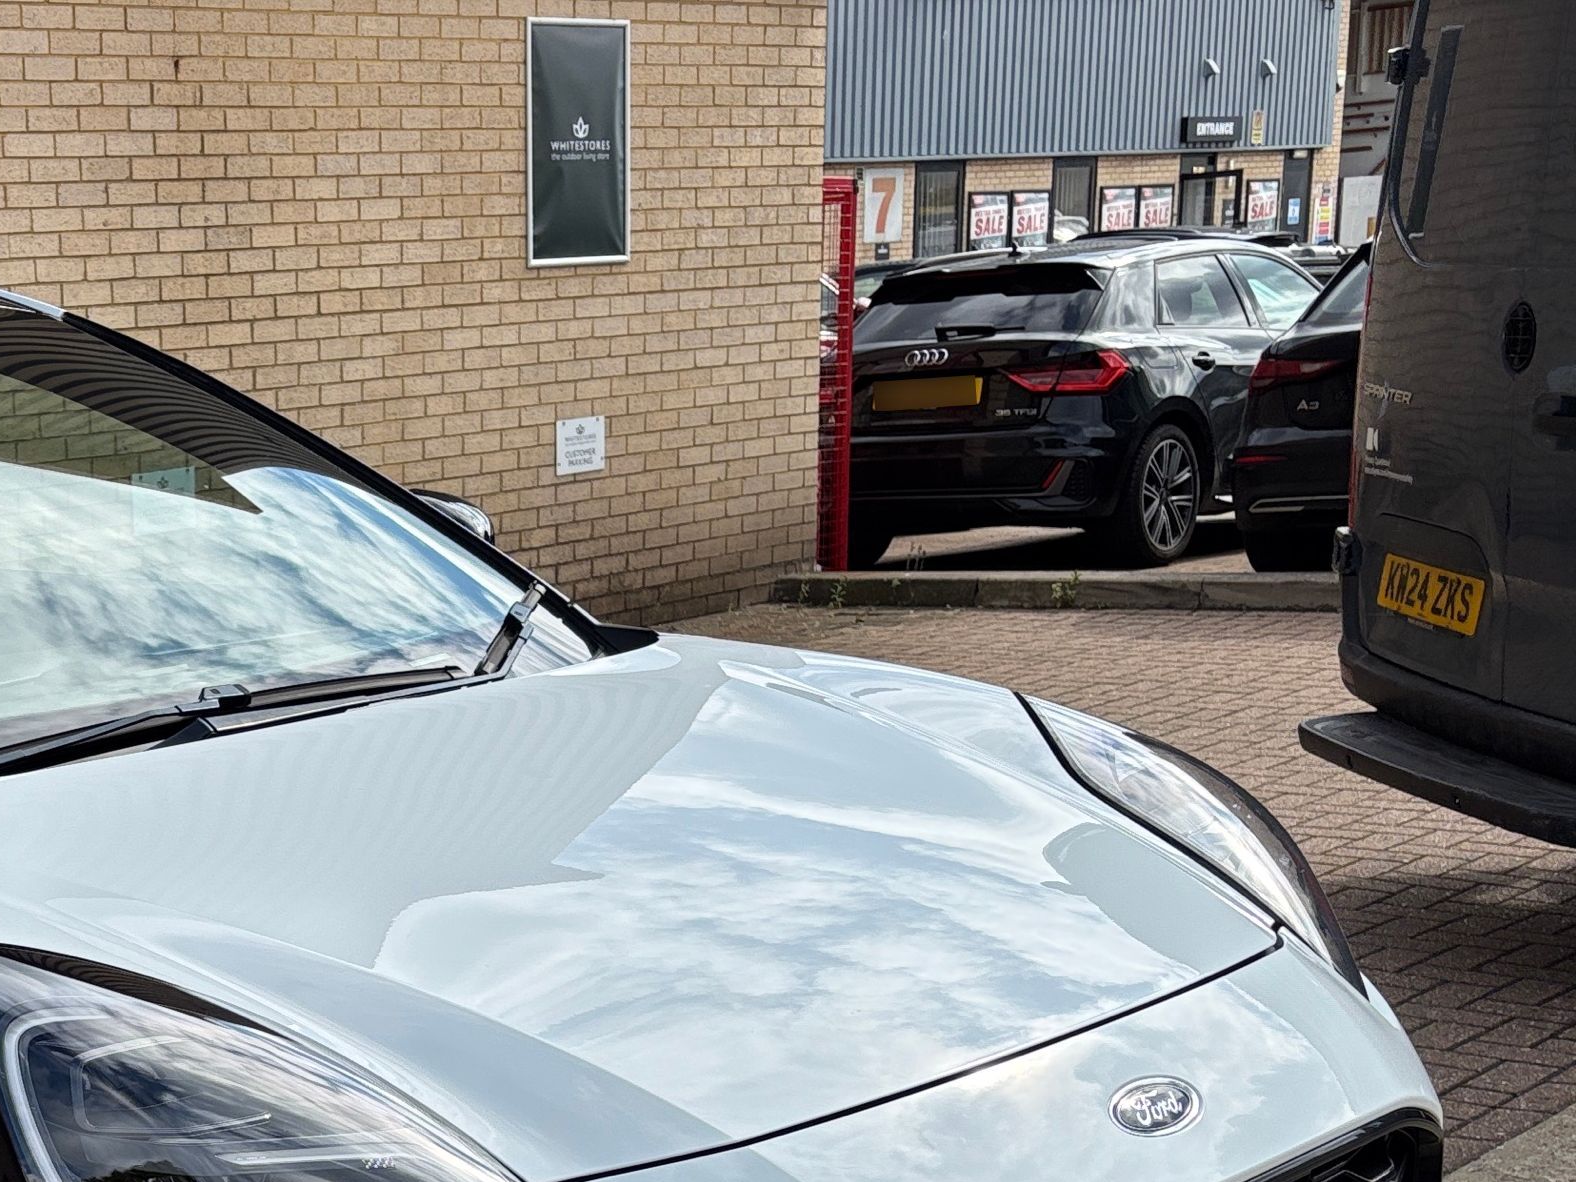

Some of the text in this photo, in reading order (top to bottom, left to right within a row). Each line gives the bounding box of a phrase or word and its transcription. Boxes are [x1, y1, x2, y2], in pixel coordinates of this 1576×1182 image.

[1196, 121, 1235, 136] ENTRANCE
[550, 140, 611, 151] WHITESTORES
[871, 177, 897, 234] 7
[1250, 200, 1275, 219] SALE
[974, 215, 1004, 236] SALE
[1016, 213, 1045, 234] SALE
[1106, 209, 1133, 229] SALE
[1144, 206, 1169, 227] SALE
[1131, 1089, 1183, 1127] Ford
